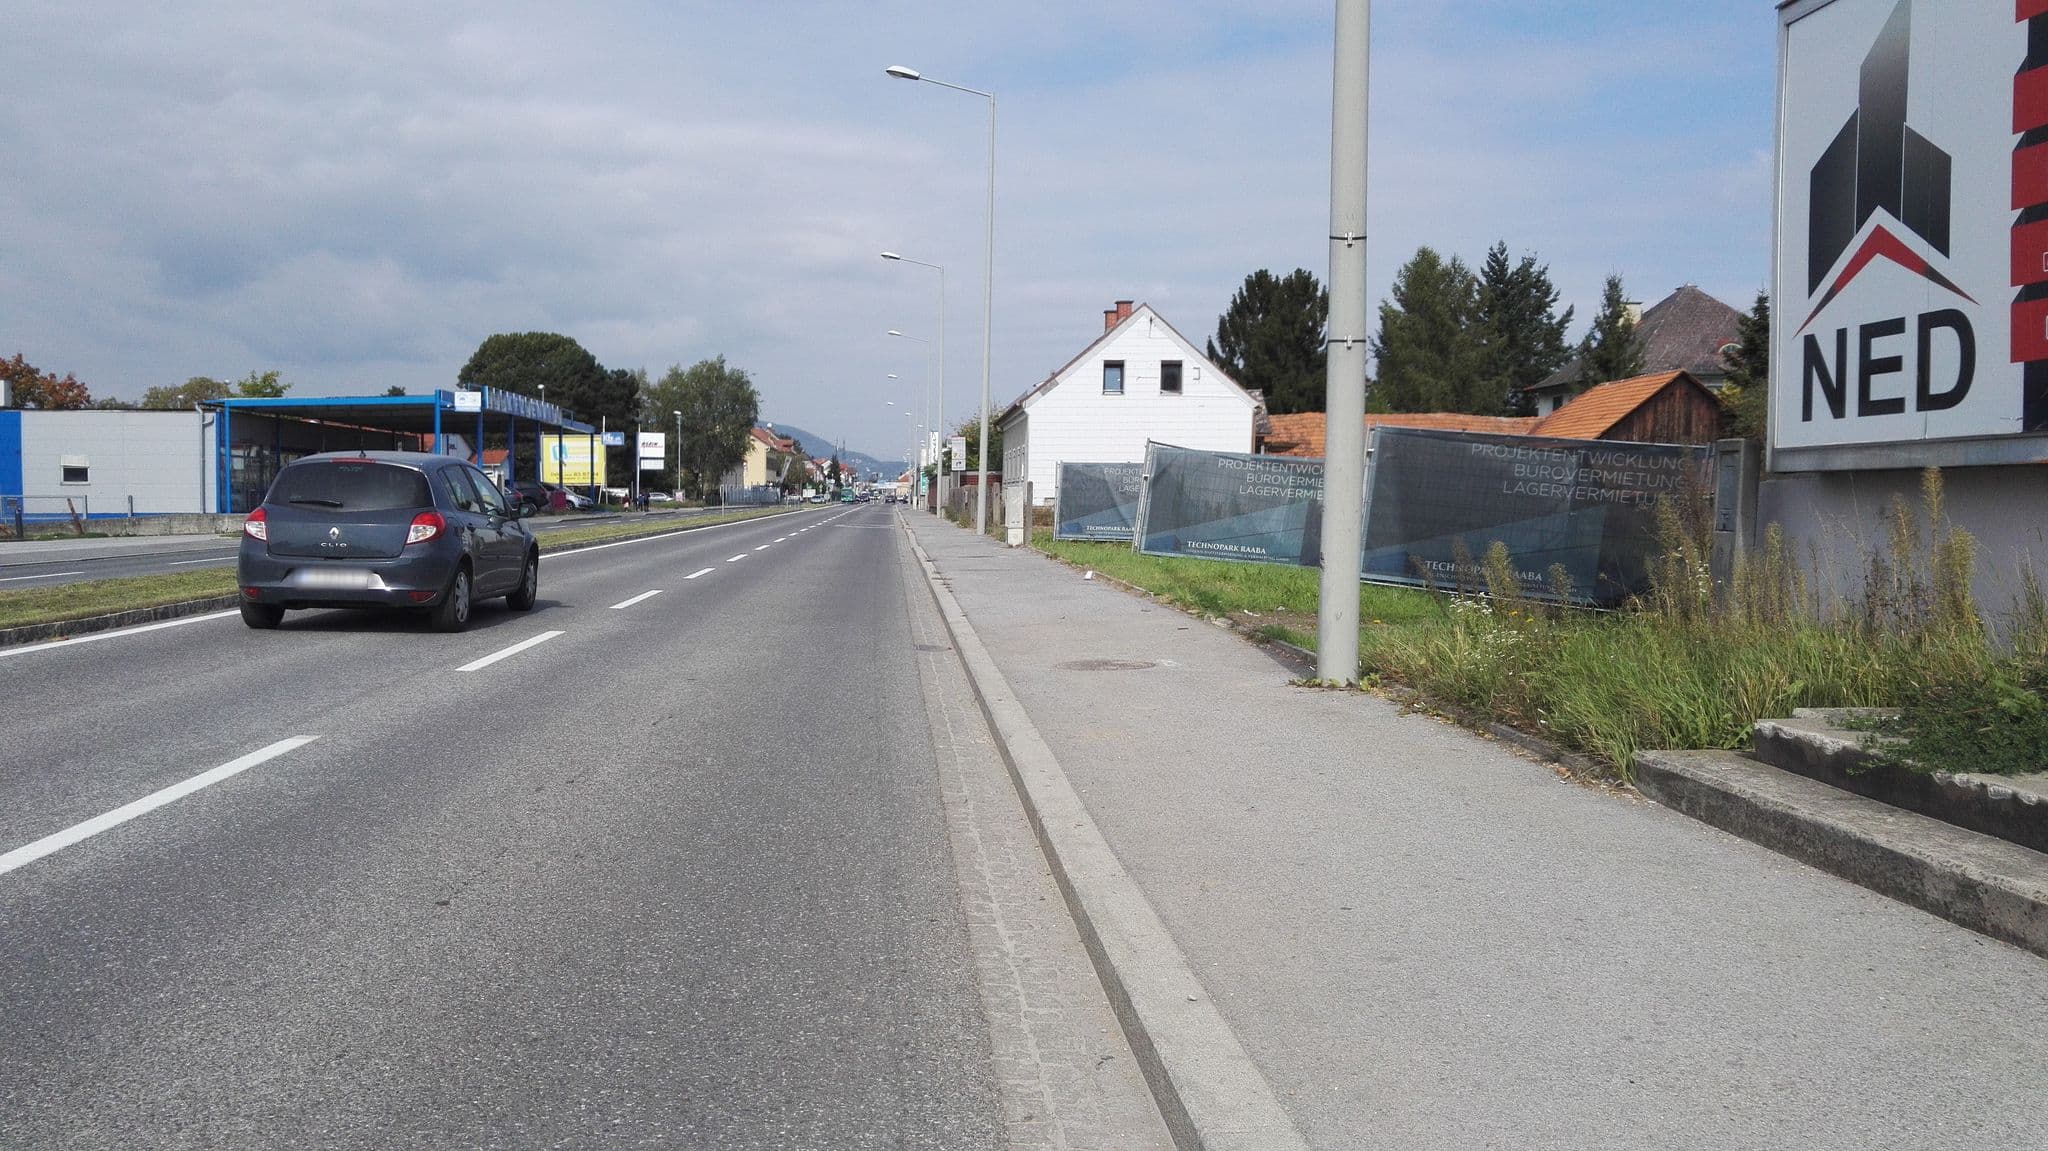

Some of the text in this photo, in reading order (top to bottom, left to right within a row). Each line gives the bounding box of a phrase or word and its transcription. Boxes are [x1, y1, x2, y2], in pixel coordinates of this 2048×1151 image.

[1802, 308, 1976, 422] NED
[1187, 541, 1266, 554] TECHNOPARK RAABA
